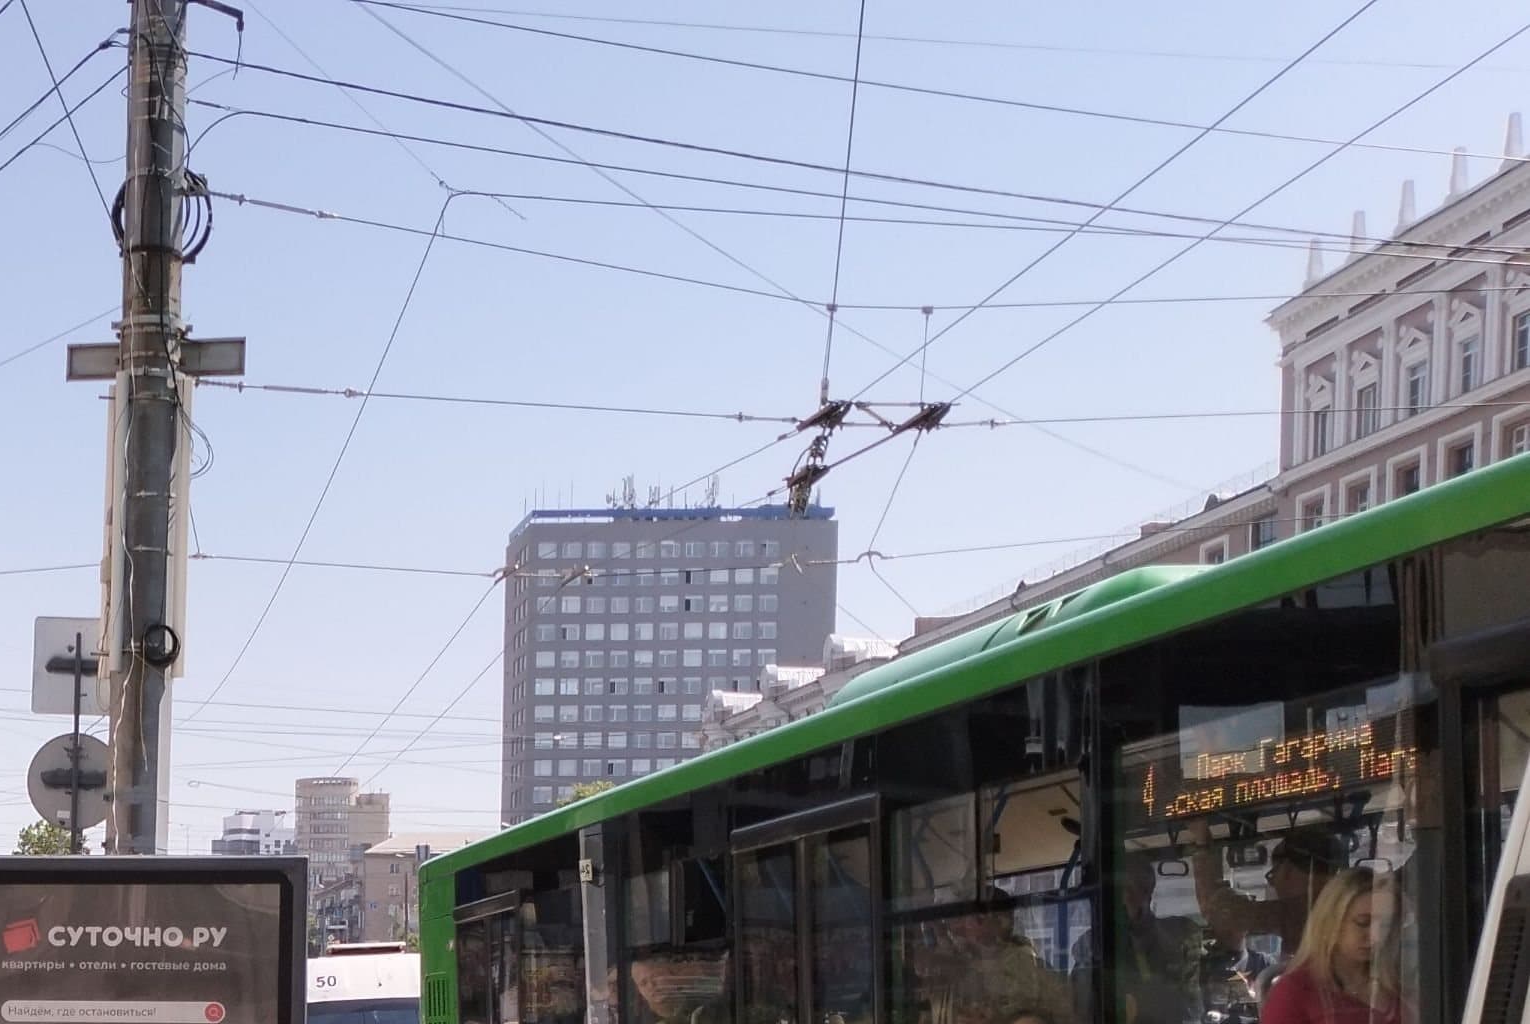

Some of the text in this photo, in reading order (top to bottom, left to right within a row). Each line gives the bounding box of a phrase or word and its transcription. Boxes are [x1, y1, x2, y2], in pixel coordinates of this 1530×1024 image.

[1197, 722, 1372, 781] Парк Гагарина
[1143, 765, 1154, 817] 4
[48, 926, 227, 947] СУТОЧНО.РУ
[1, 959, 227, 972] квартиры отели гостевые дома
[315, 975, 337, 988] 50
[57, 1008, 76, 1018] где
[78, 1006, 157, 1018] остановиться!
